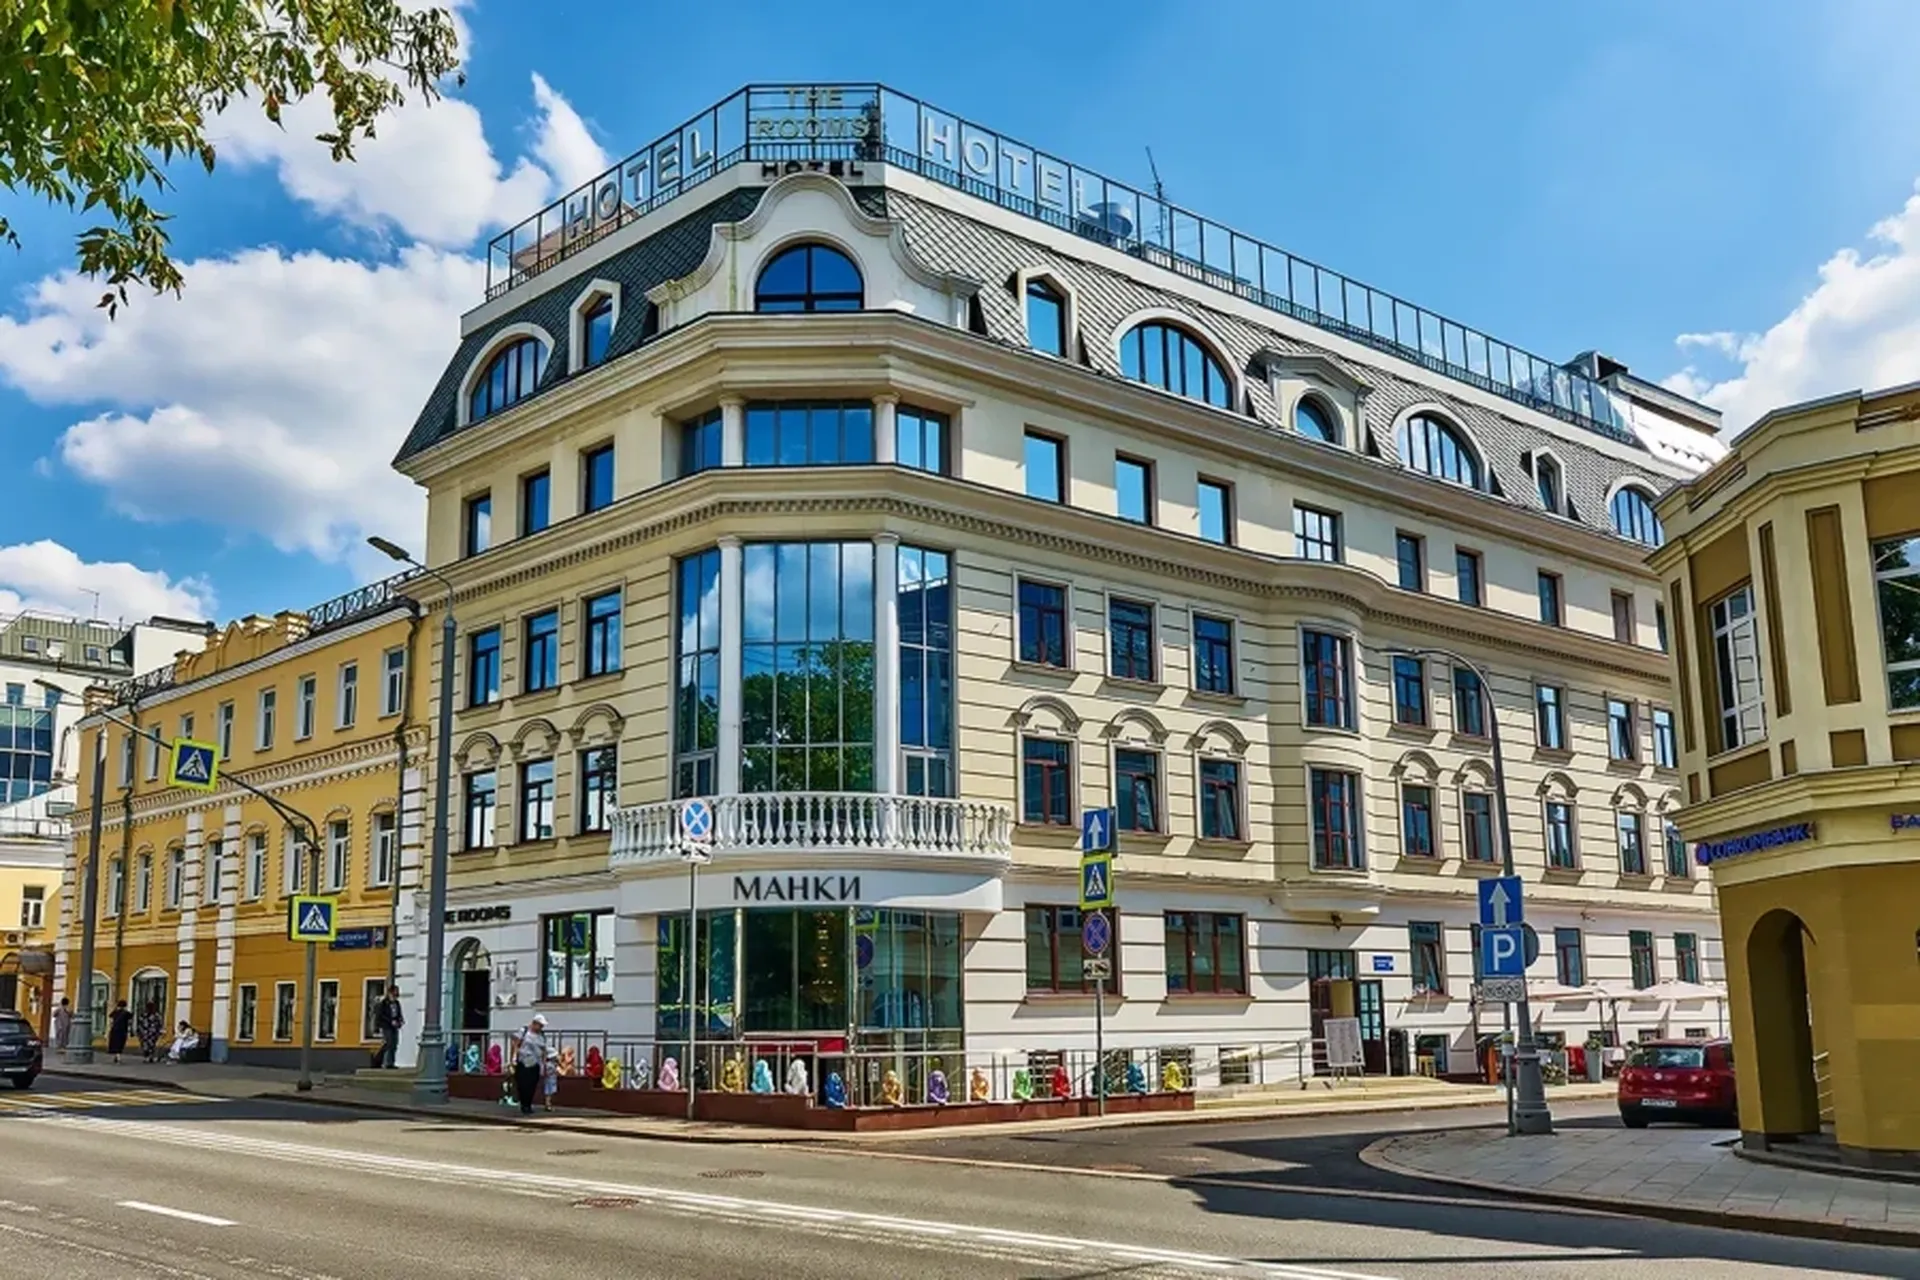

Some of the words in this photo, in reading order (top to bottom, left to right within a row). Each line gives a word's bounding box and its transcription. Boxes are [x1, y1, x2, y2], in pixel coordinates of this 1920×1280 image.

[784, 88, 844, 108] THE
[756, 118, 870, 139] ROOMS
[923, 115, 1100, 219] HOTEL
[567, 130, 713, 239] HOTEL
[733, 876, 860, 901] МАНКИ
